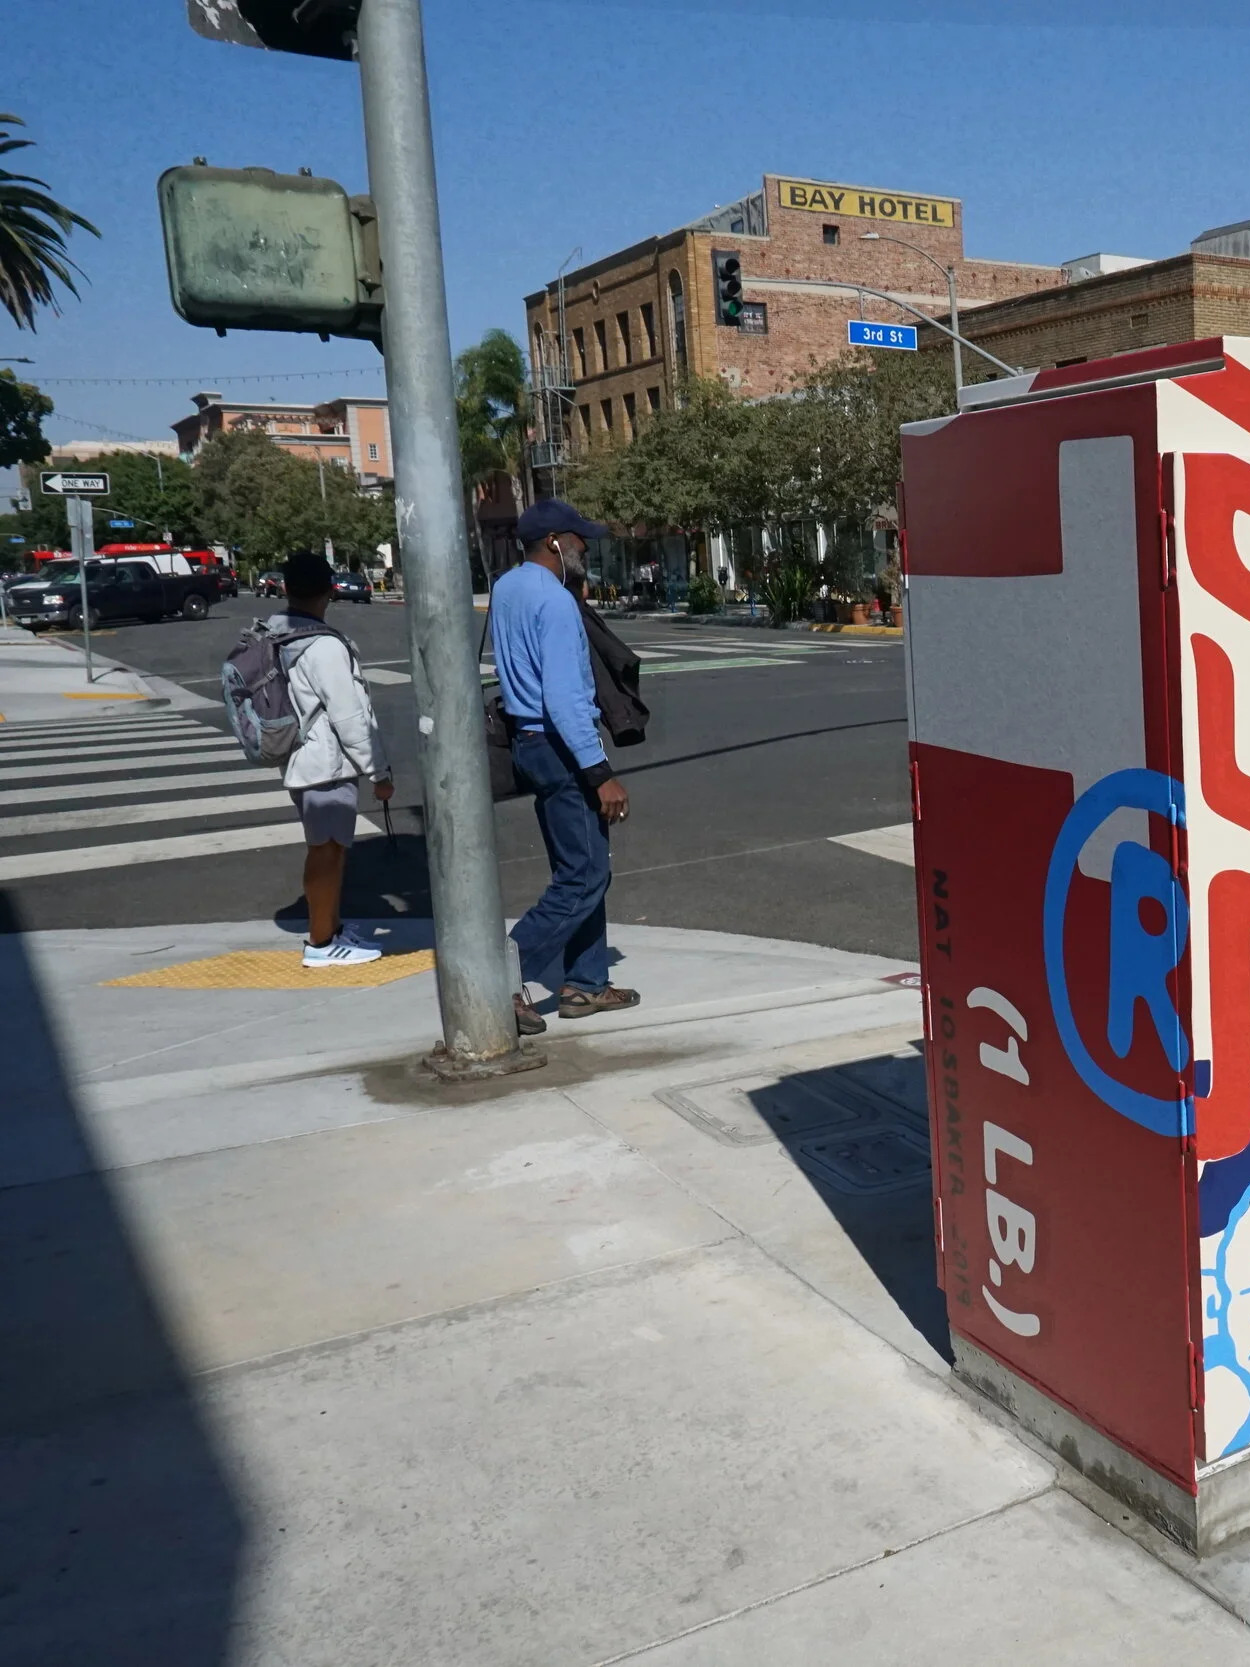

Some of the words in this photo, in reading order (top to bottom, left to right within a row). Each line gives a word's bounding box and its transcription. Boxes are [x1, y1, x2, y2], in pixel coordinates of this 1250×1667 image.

[790, 187, 845, 211] BAY
[859, 196, 944, 223] HOTEL
[863, 328, 883, 342] 3rd
[889, 331, 903, 343] St
[62, 479, 80, 488] ONE
[83, 480, 101, 488] WAY
[930, 868, 953, 963] NAT
[966, 986, 1030, 1086] (1
[982, 1120, 1041, 1337] LB.)
